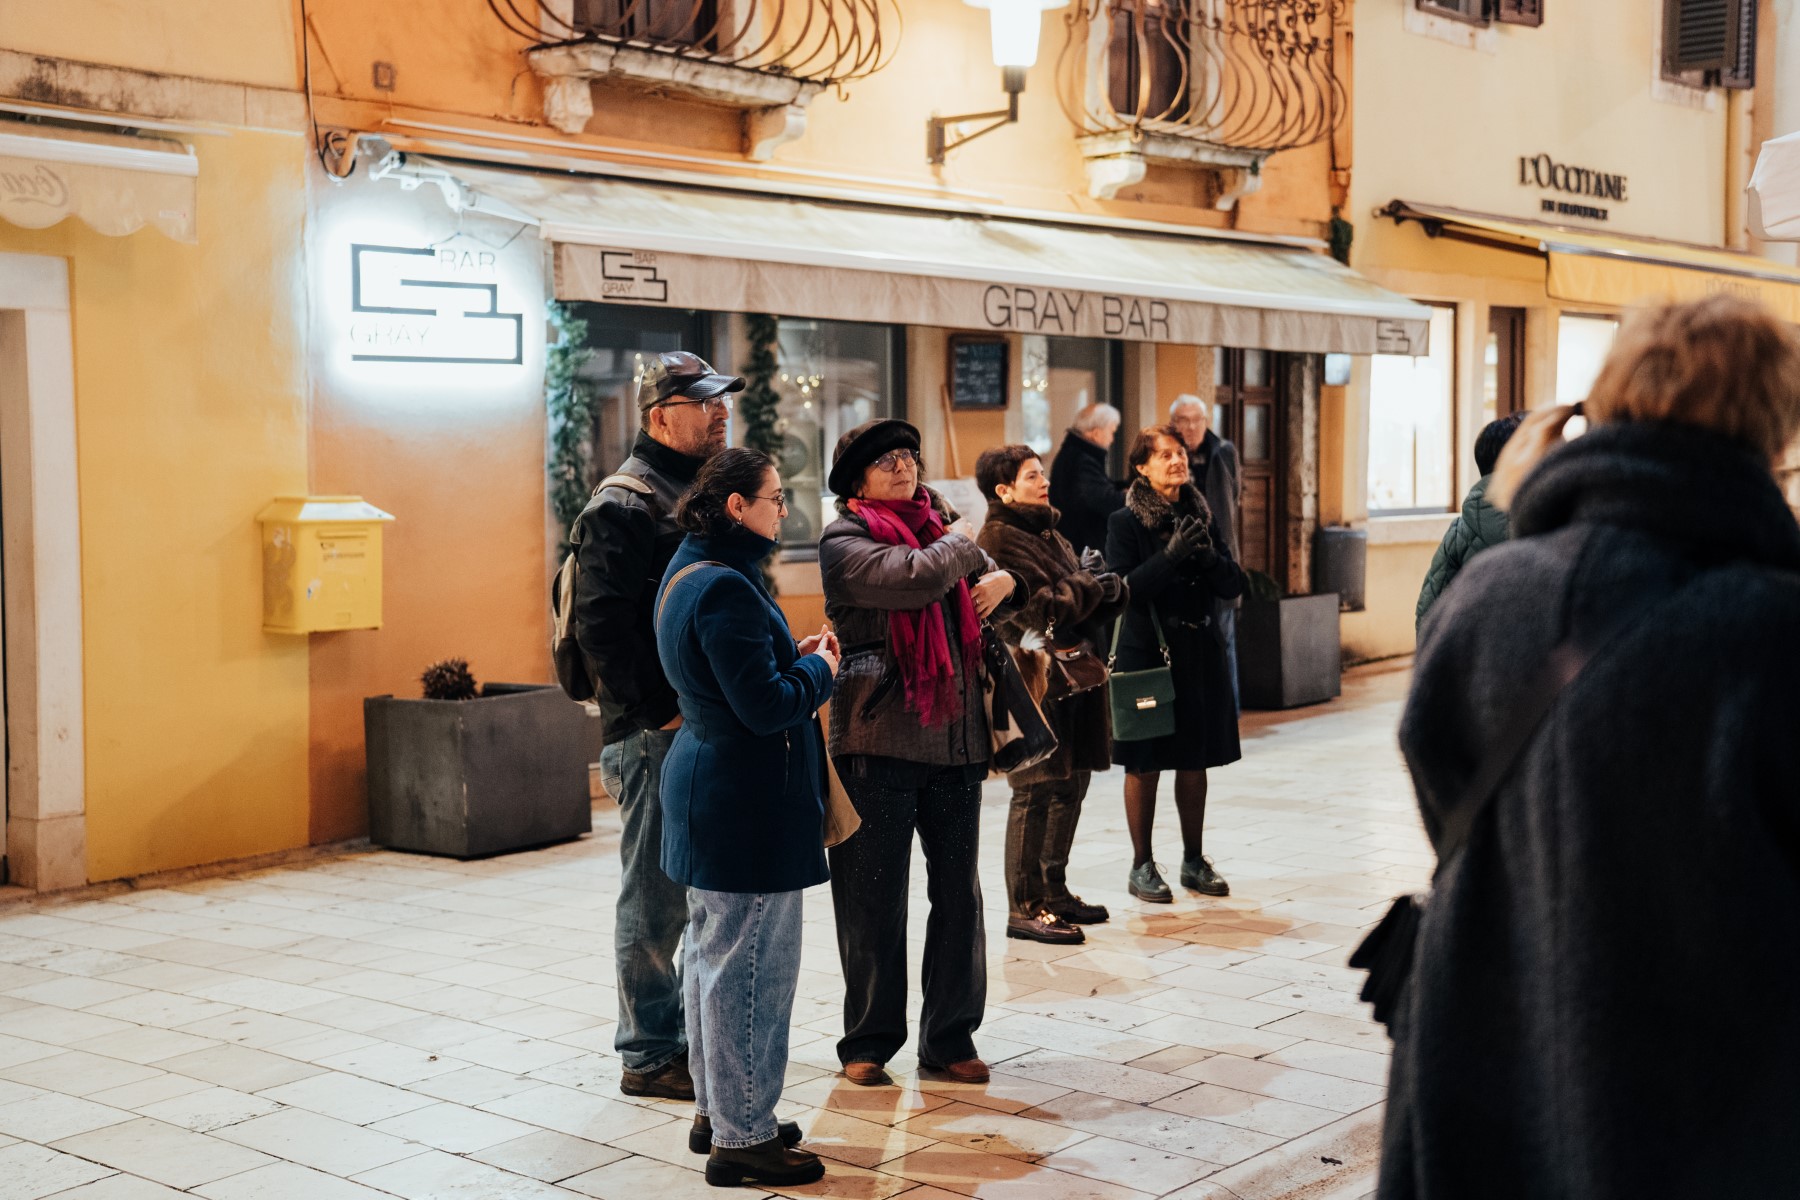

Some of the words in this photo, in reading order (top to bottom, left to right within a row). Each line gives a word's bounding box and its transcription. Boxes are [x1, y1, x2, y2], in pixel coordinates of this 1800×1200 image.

[440, 249, 495, 274] BAR
[634, 251, 657, 265] BAR
[601, 281, 632, 294] GRAY
[984, 284, 1084, 332] GRAY
[1102, 295, 1170, 339] BAR
[350, 322, 430, 346] GRAY
